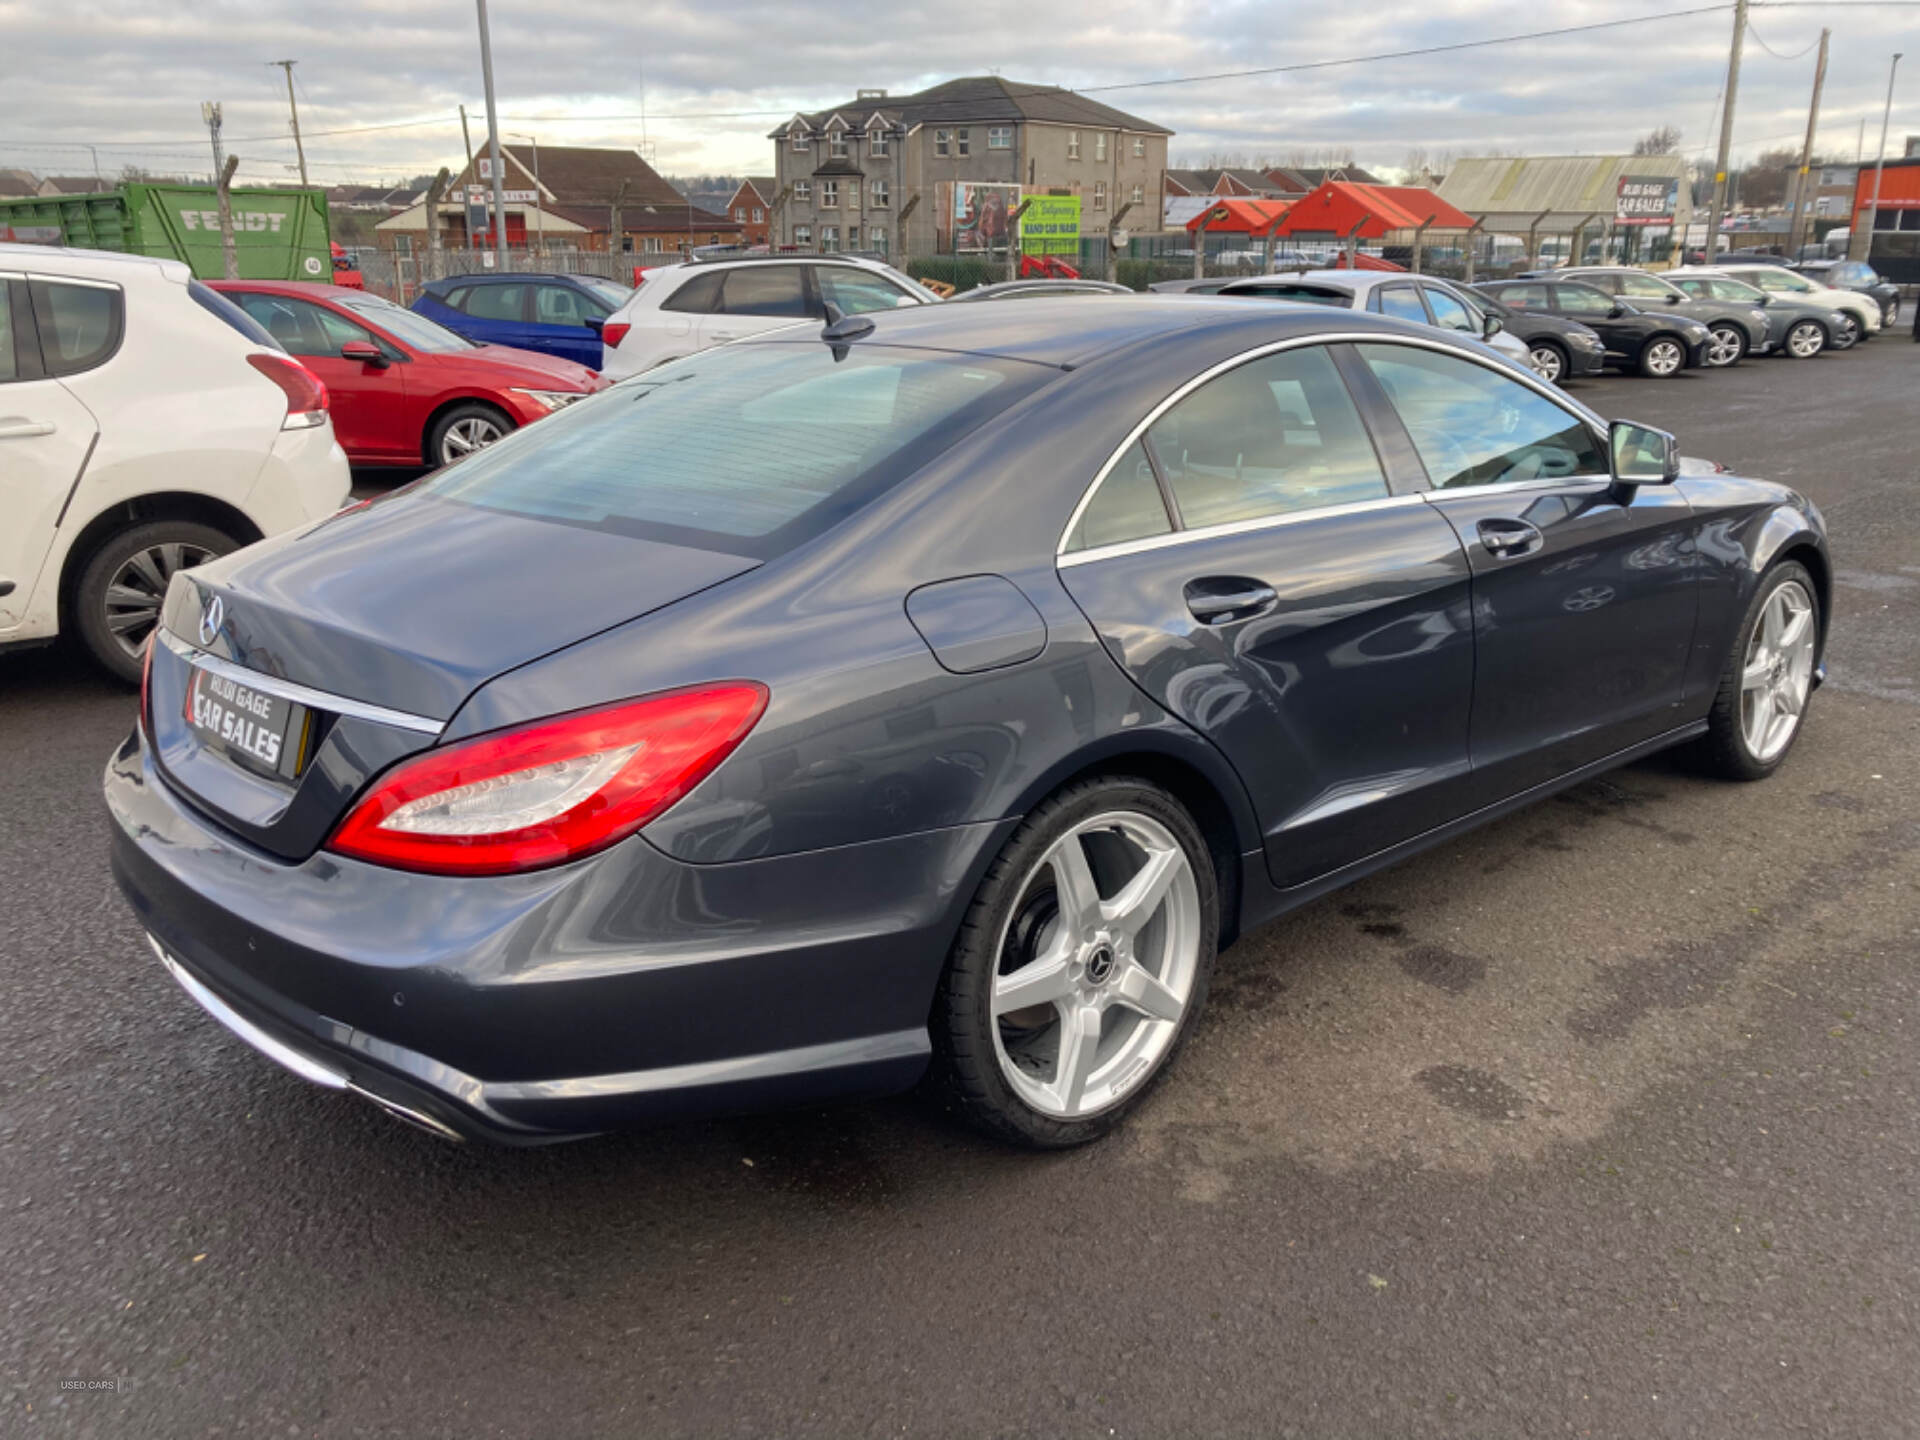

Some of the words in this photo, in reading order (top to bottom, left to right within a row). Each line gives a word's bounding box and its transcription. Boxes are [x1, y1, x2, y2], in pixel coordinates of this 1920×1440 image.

[1616, 198, 1635, 213] CAR
[1635, 198, 1666, 213] SALES
[180, 210, 287, 232] FENDT
[1024, 223, 1044, 234] HAND
[1045, 223, 1058, 234] CAR
[1060, 223, 1077, 233] WASH
[210, 674, 236, 702] RUDI
[236, 686, 272, 719] GAGE
[193, 691, 222, 732] CAR
[221, 710, 281, 764] SALES
